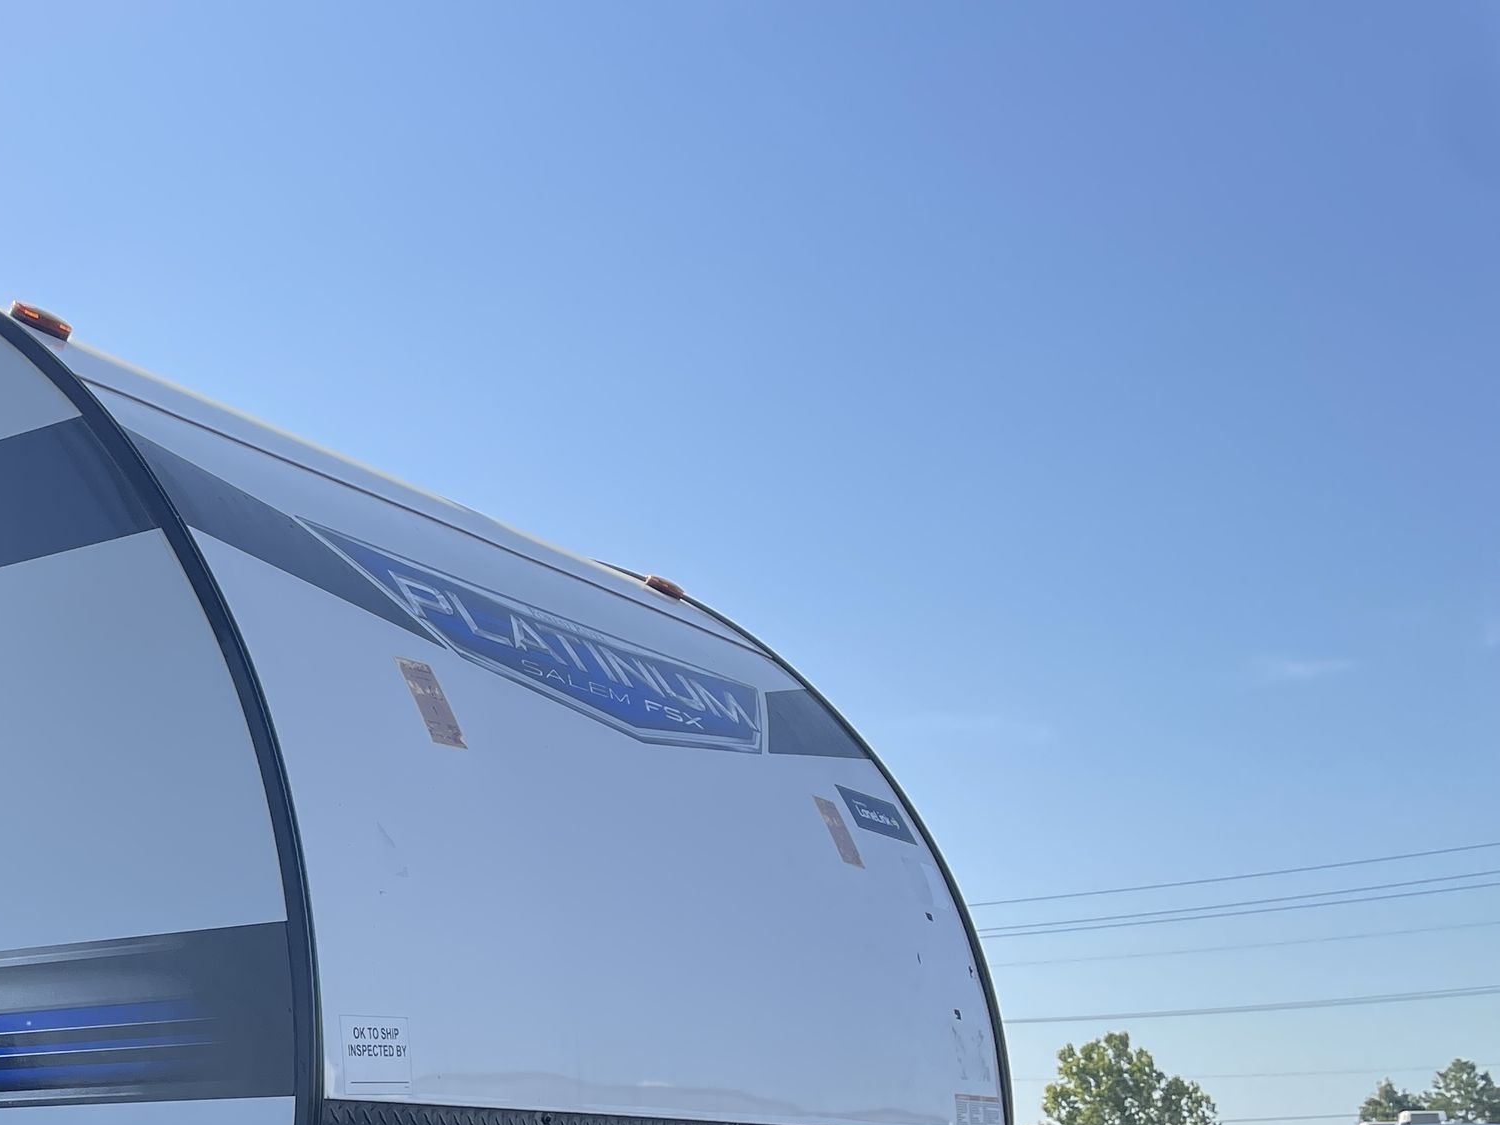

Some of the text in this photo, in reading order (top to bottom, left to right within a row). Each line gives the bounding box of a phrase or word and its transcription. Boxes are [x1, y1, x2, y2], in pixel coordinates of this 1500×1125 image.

[388, 570, 761, 732] PLATINUM
[521, 659, 705, 729] SALEM FSX
[347, 1044, 407, 1057] INSPECTED BY
[353, 1026, 400, 1040] OK TO SHIP
